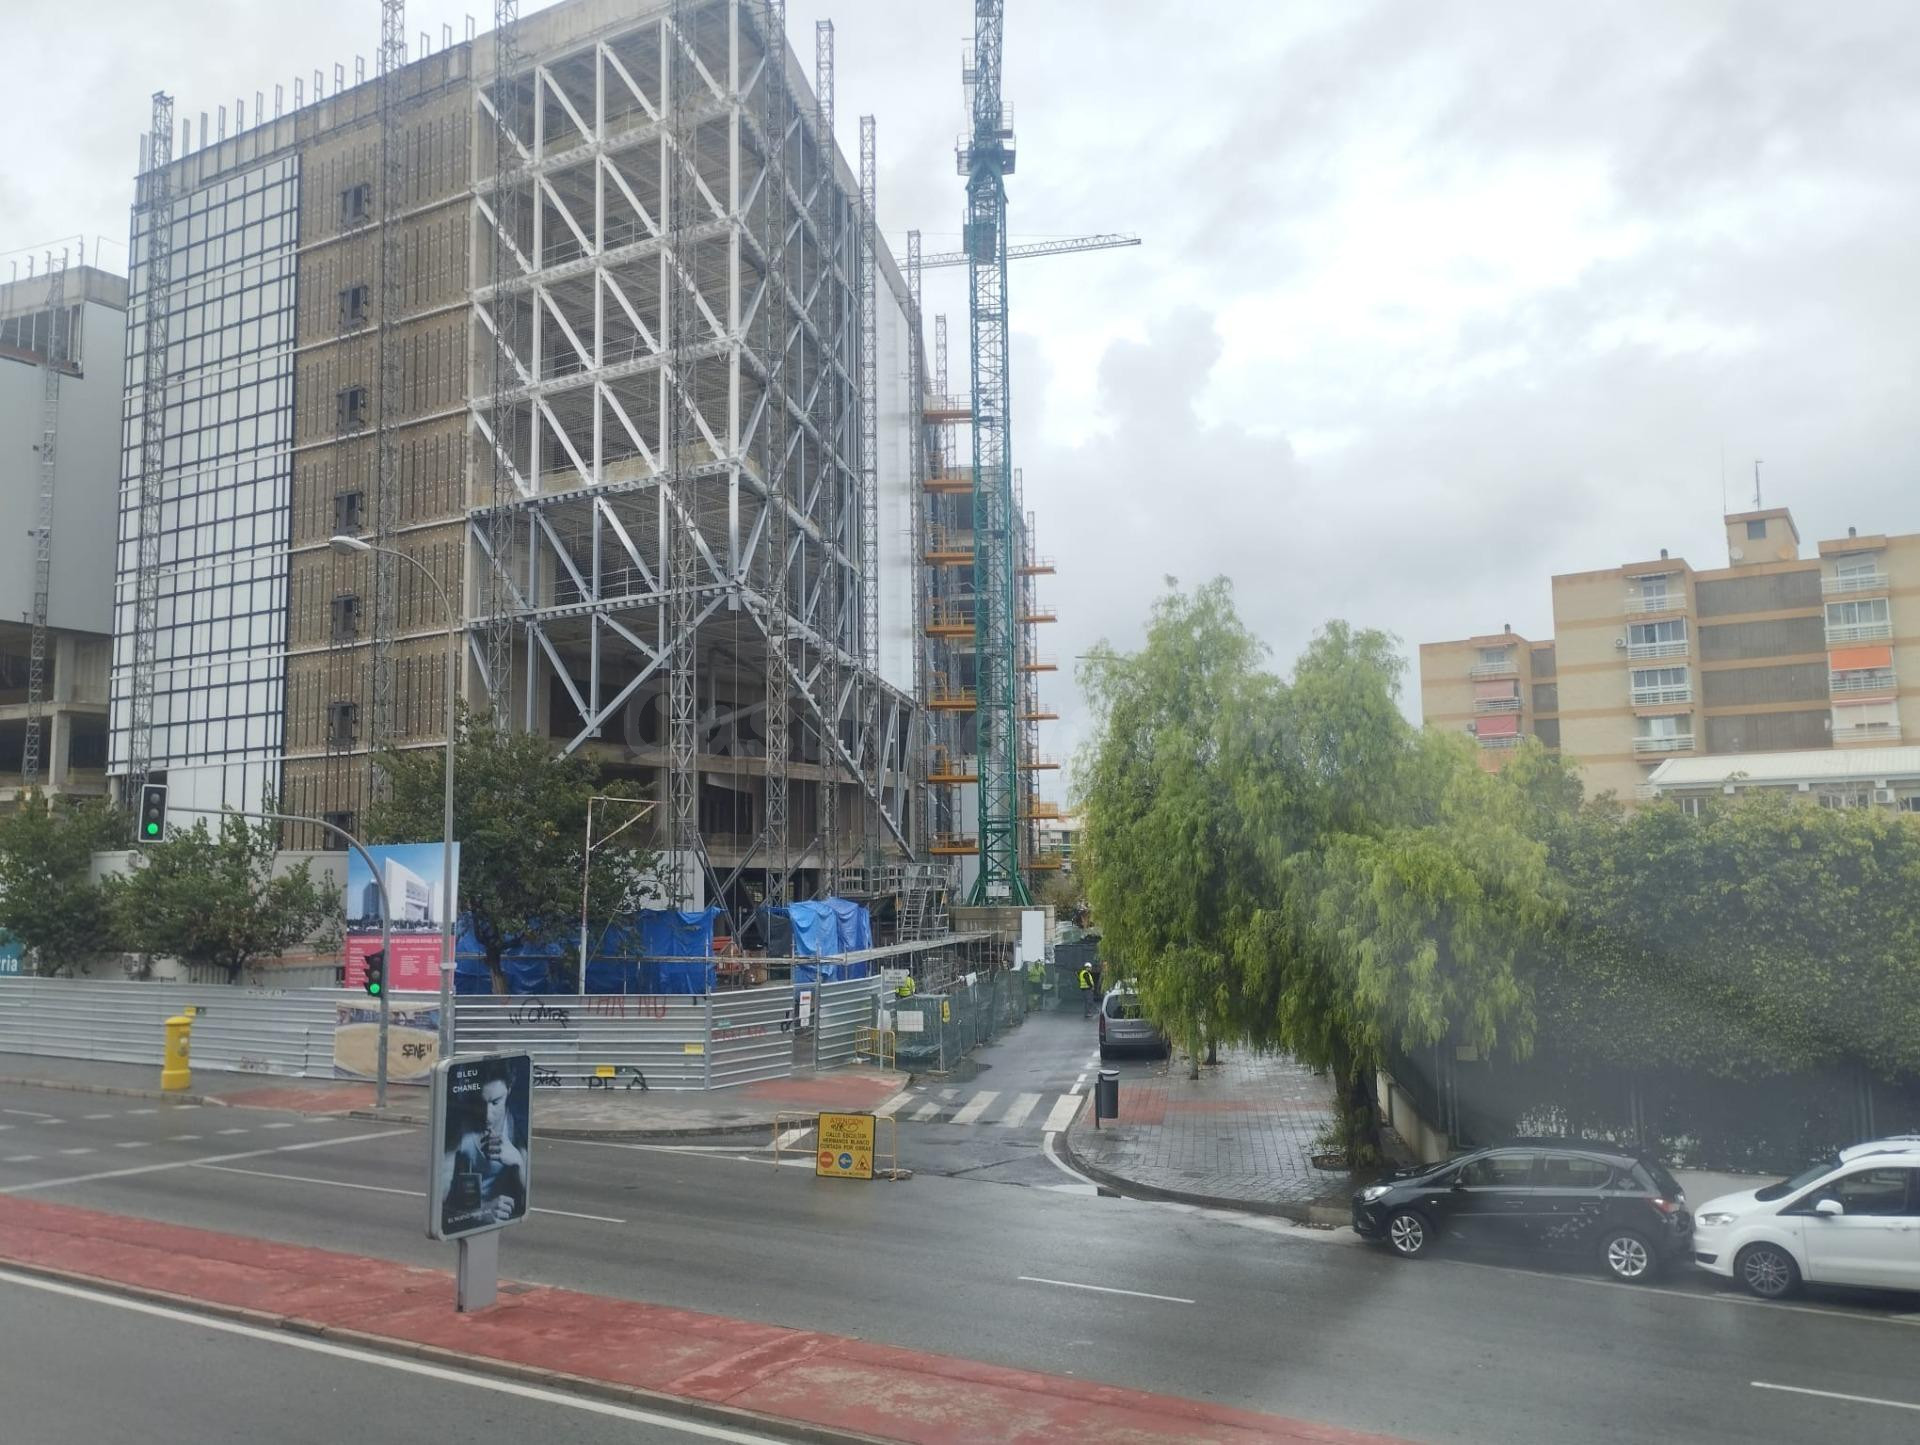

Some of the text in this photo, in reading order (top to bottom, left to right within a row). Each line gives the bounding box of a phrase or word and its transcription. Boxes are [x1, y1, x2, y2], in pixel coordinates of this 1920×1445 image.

[0, 954, 18, 972] ria
[456, 1069, 478, 1079] BLEU
[452, 1083, 481, 1094] CHANEL
